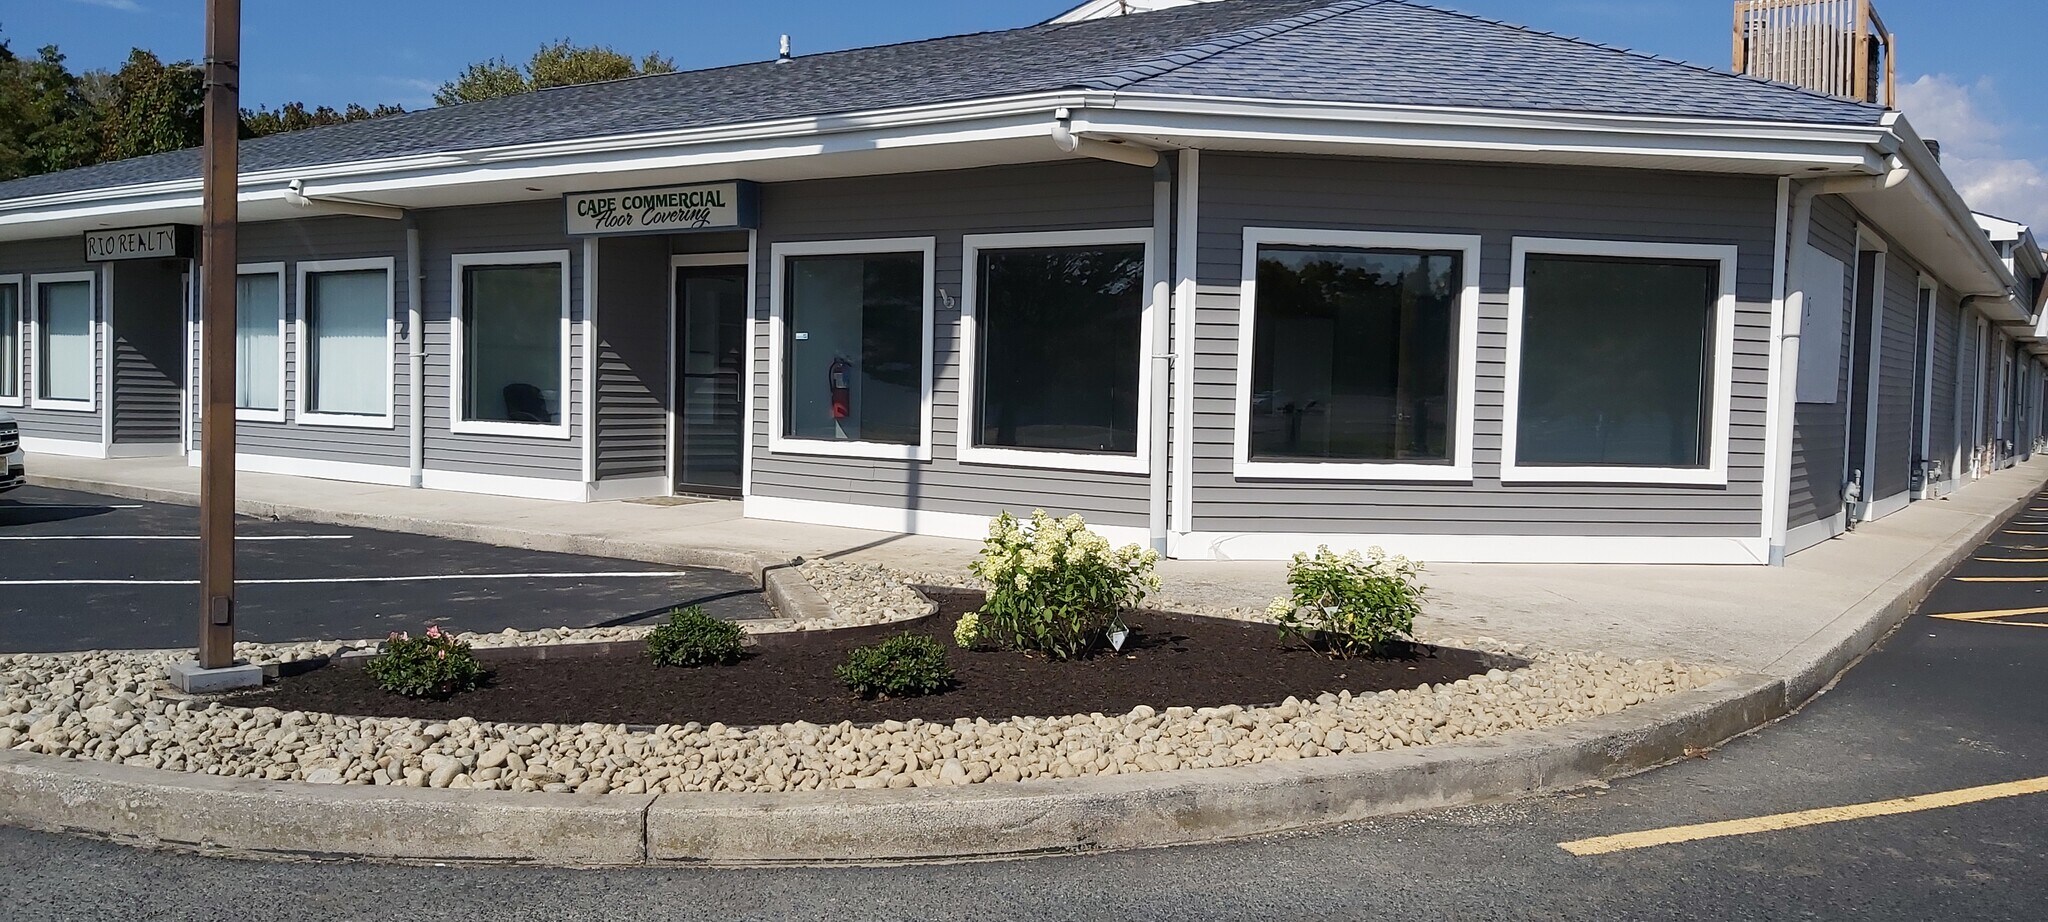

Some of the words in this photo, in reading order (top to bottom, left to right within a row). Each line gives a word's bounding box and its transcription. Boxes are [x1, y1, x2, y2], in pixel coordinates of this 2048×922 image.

[577, 198, 616, 217] CAPE
[621, 190, 726, 210] COMMERCIAL
[595, 207, 633, 229] Floor
[641, 206, 711, 229] Covering
[88, 236, 115, 256] RIO
[118, 230, 174, 254] REALTY
